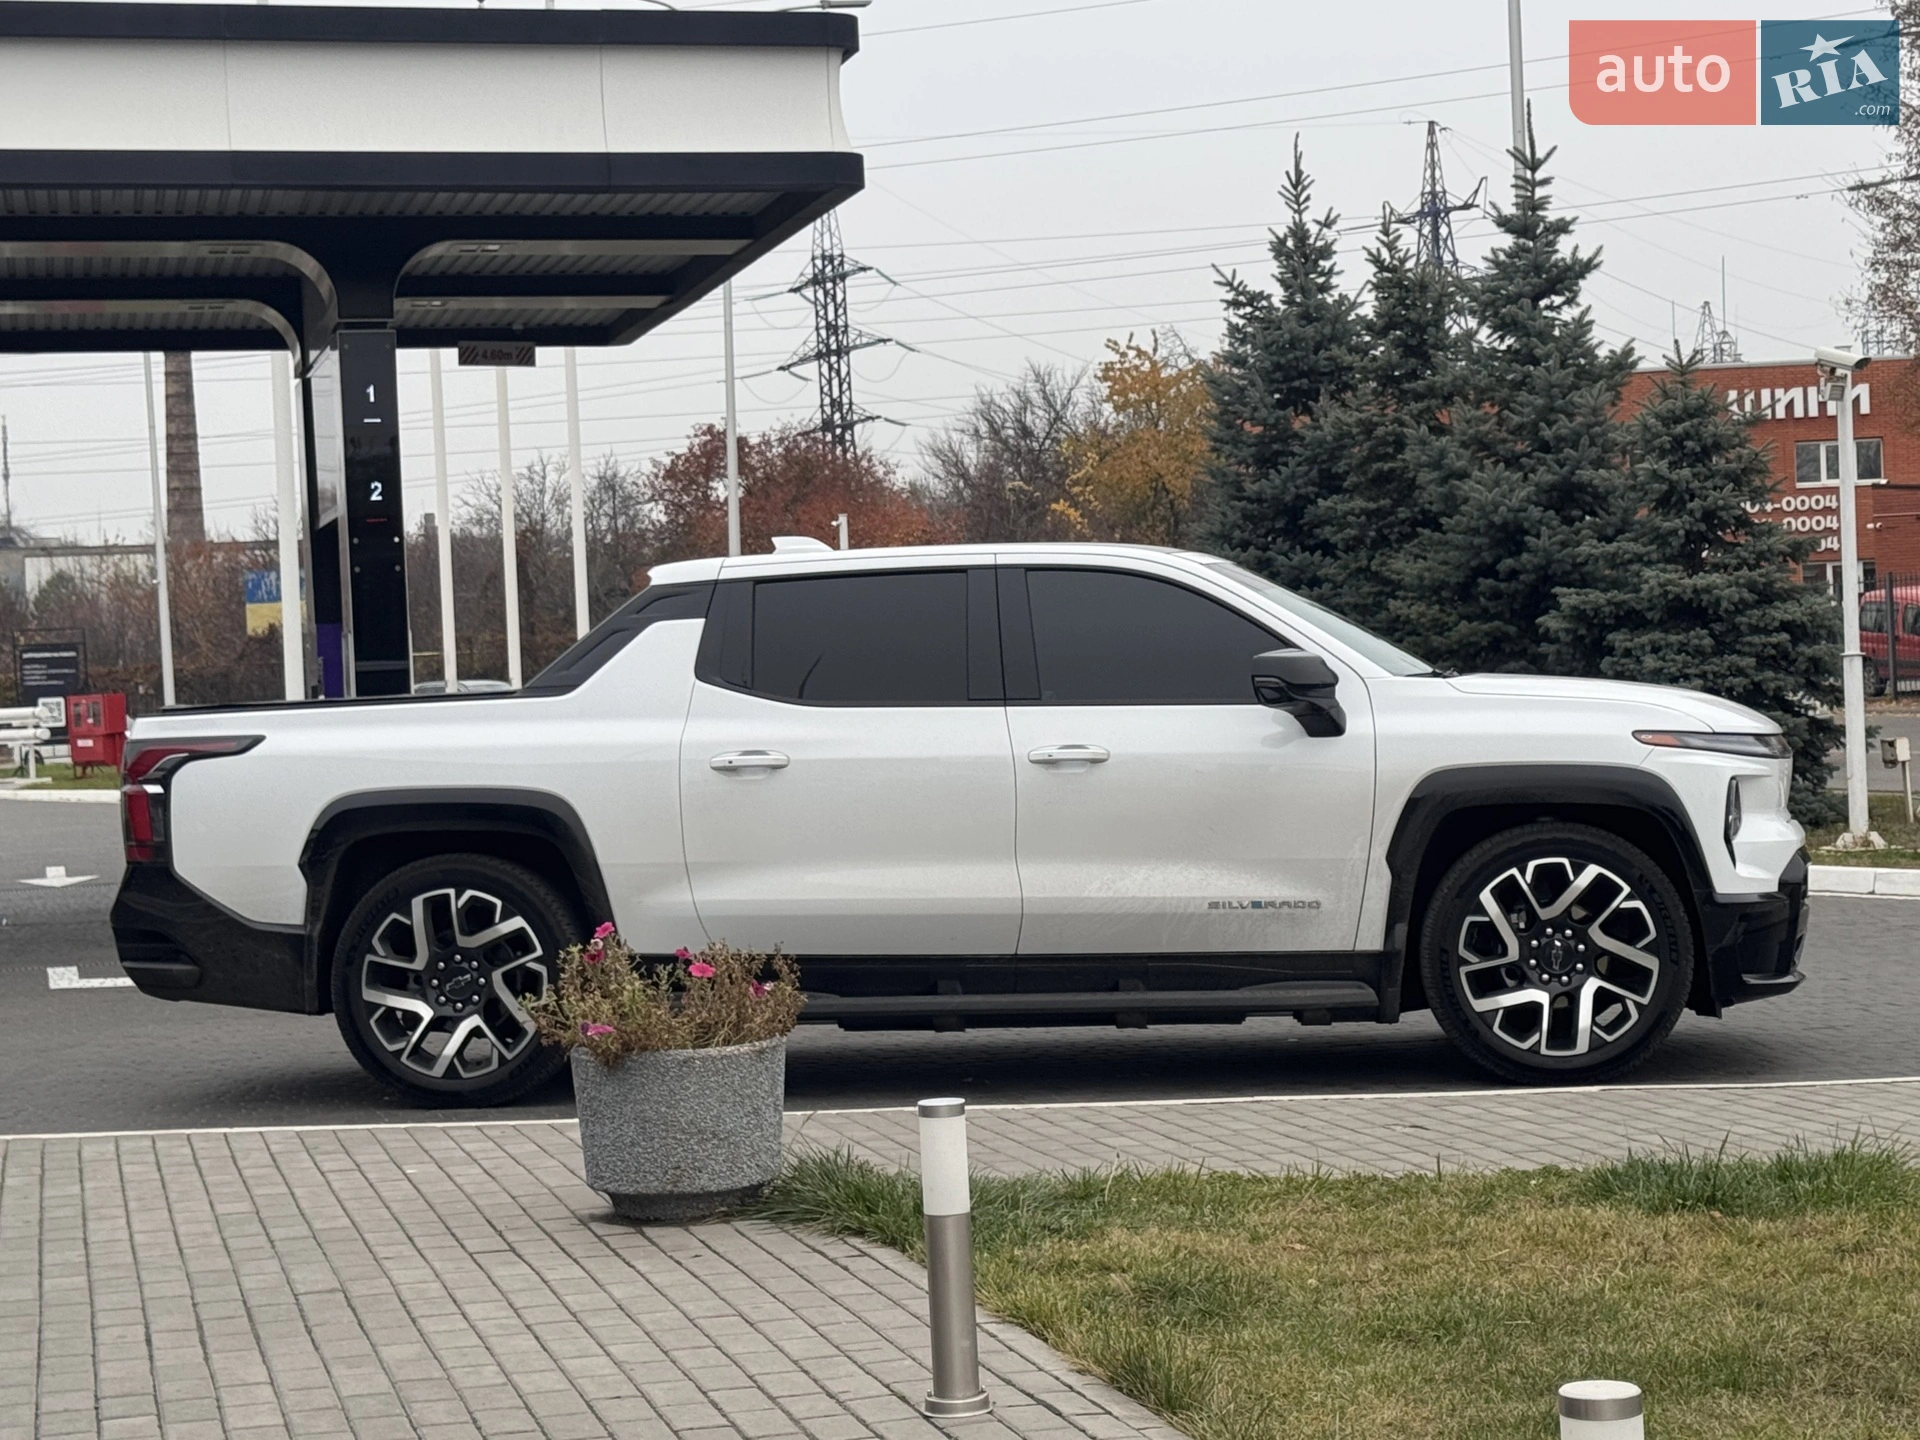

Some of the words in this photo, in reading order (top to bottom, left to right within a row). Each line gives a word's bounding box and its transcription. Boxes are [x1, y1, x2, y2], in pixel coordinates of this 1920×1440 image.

[366, 384, 375, 403] 1
[370, 481, 383, 501] 2
[1207, 900, 1322, 910] SILVERADO
